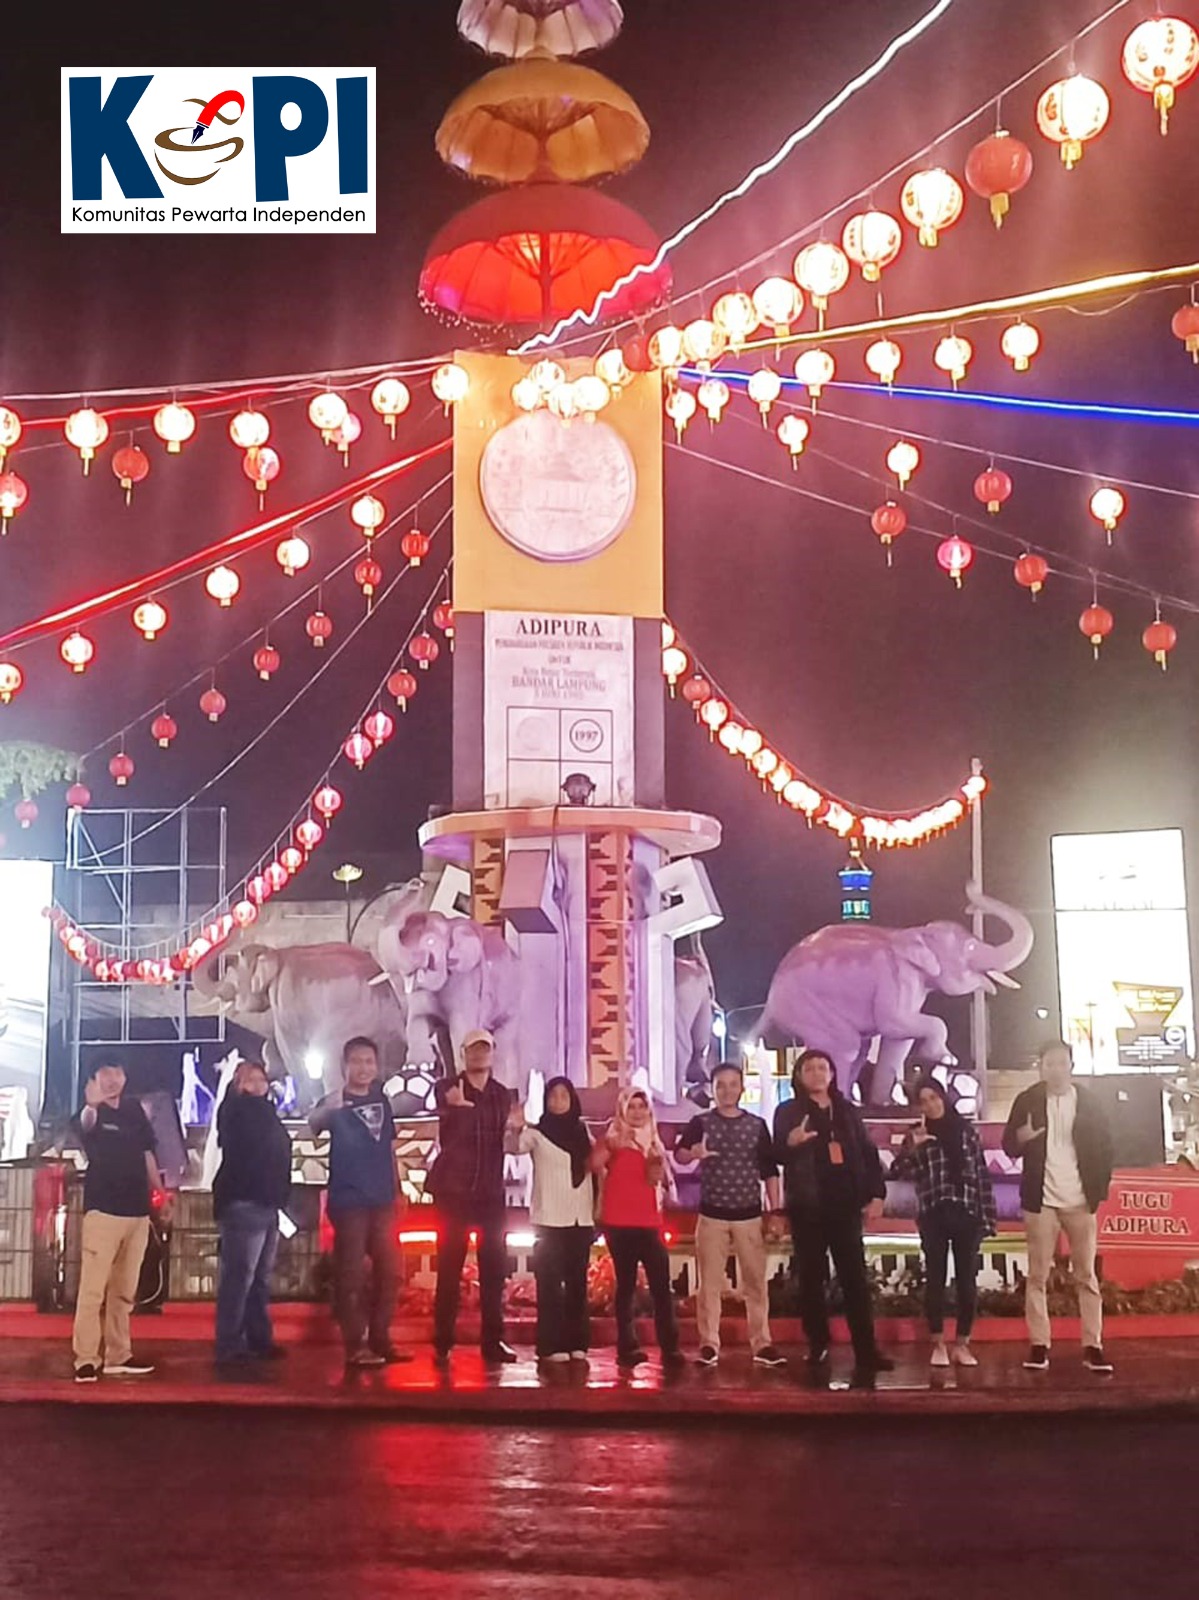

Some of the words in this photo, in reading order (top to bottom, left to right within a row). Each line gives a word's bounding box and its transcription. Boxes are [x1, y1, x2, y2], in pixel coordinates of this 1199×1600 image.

[516, 618, 602, 637] ADIPURA
[512, 675, 553, 690] BANDAR
[556, 677, 606, 693] LAMPUNG
[575, 730, 598, 741] 1997
[1120, 1192, 1170, 1209] TUGU
[1103, 1216, 1189, 1234] ADIPURA
